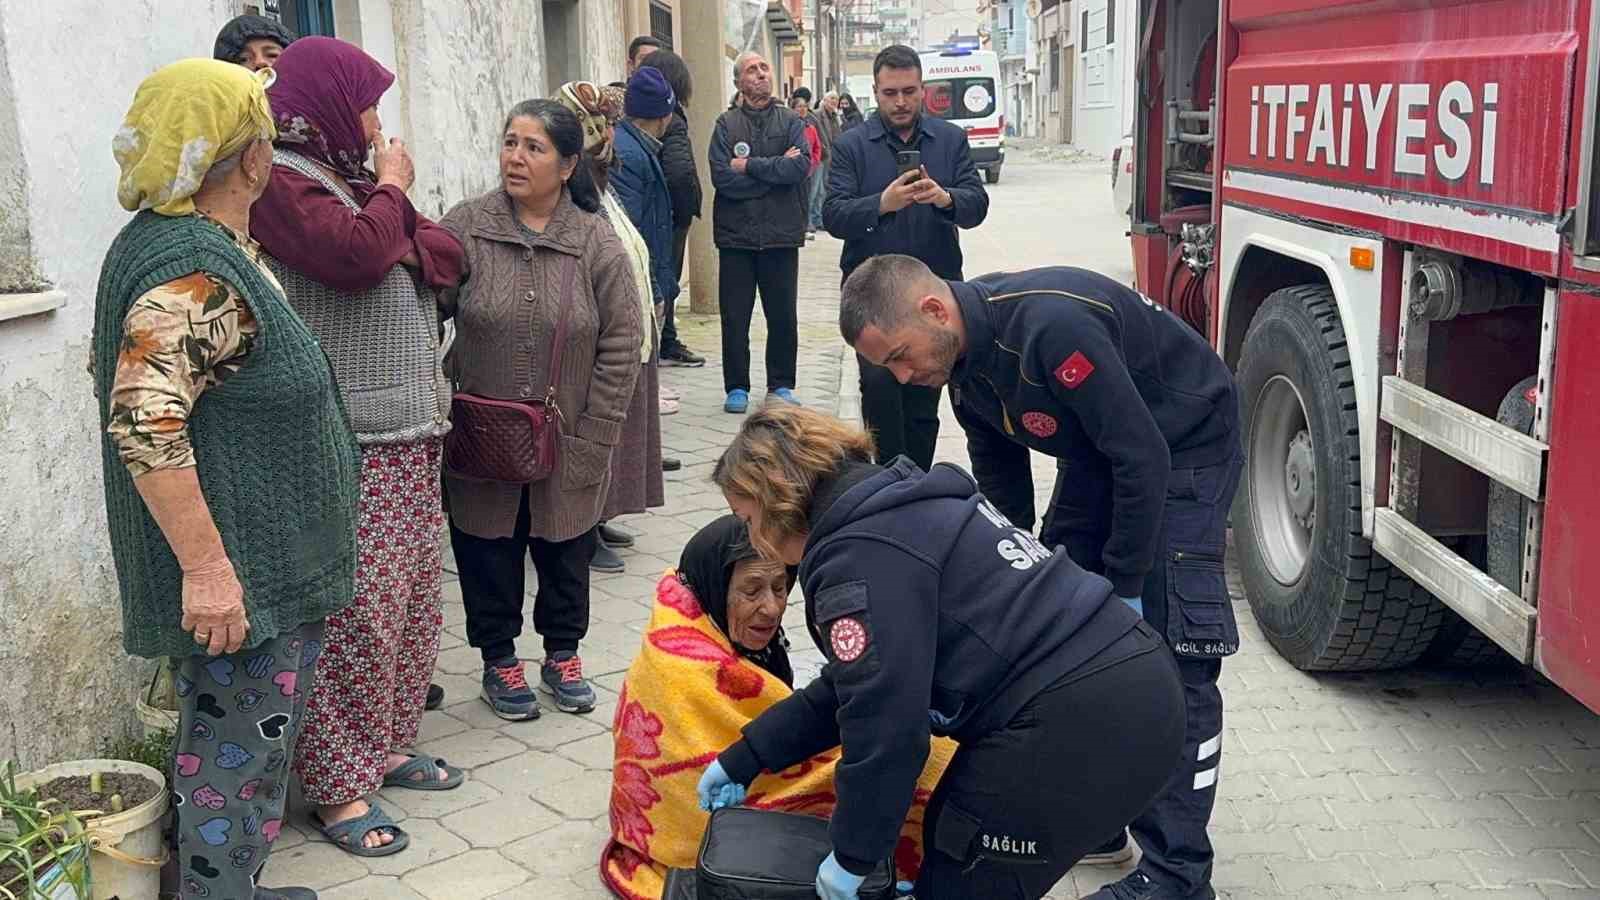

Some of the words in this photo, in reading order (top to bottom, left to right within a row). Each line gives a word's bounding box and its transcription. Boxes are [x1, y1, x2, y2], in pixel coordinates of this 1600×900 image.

[929, 64, 982, 75] AMBULANS
[1250, 80, 1498, 184] İTFAİYESİ
[982, 834, 1036, 855] SAĞLIK
